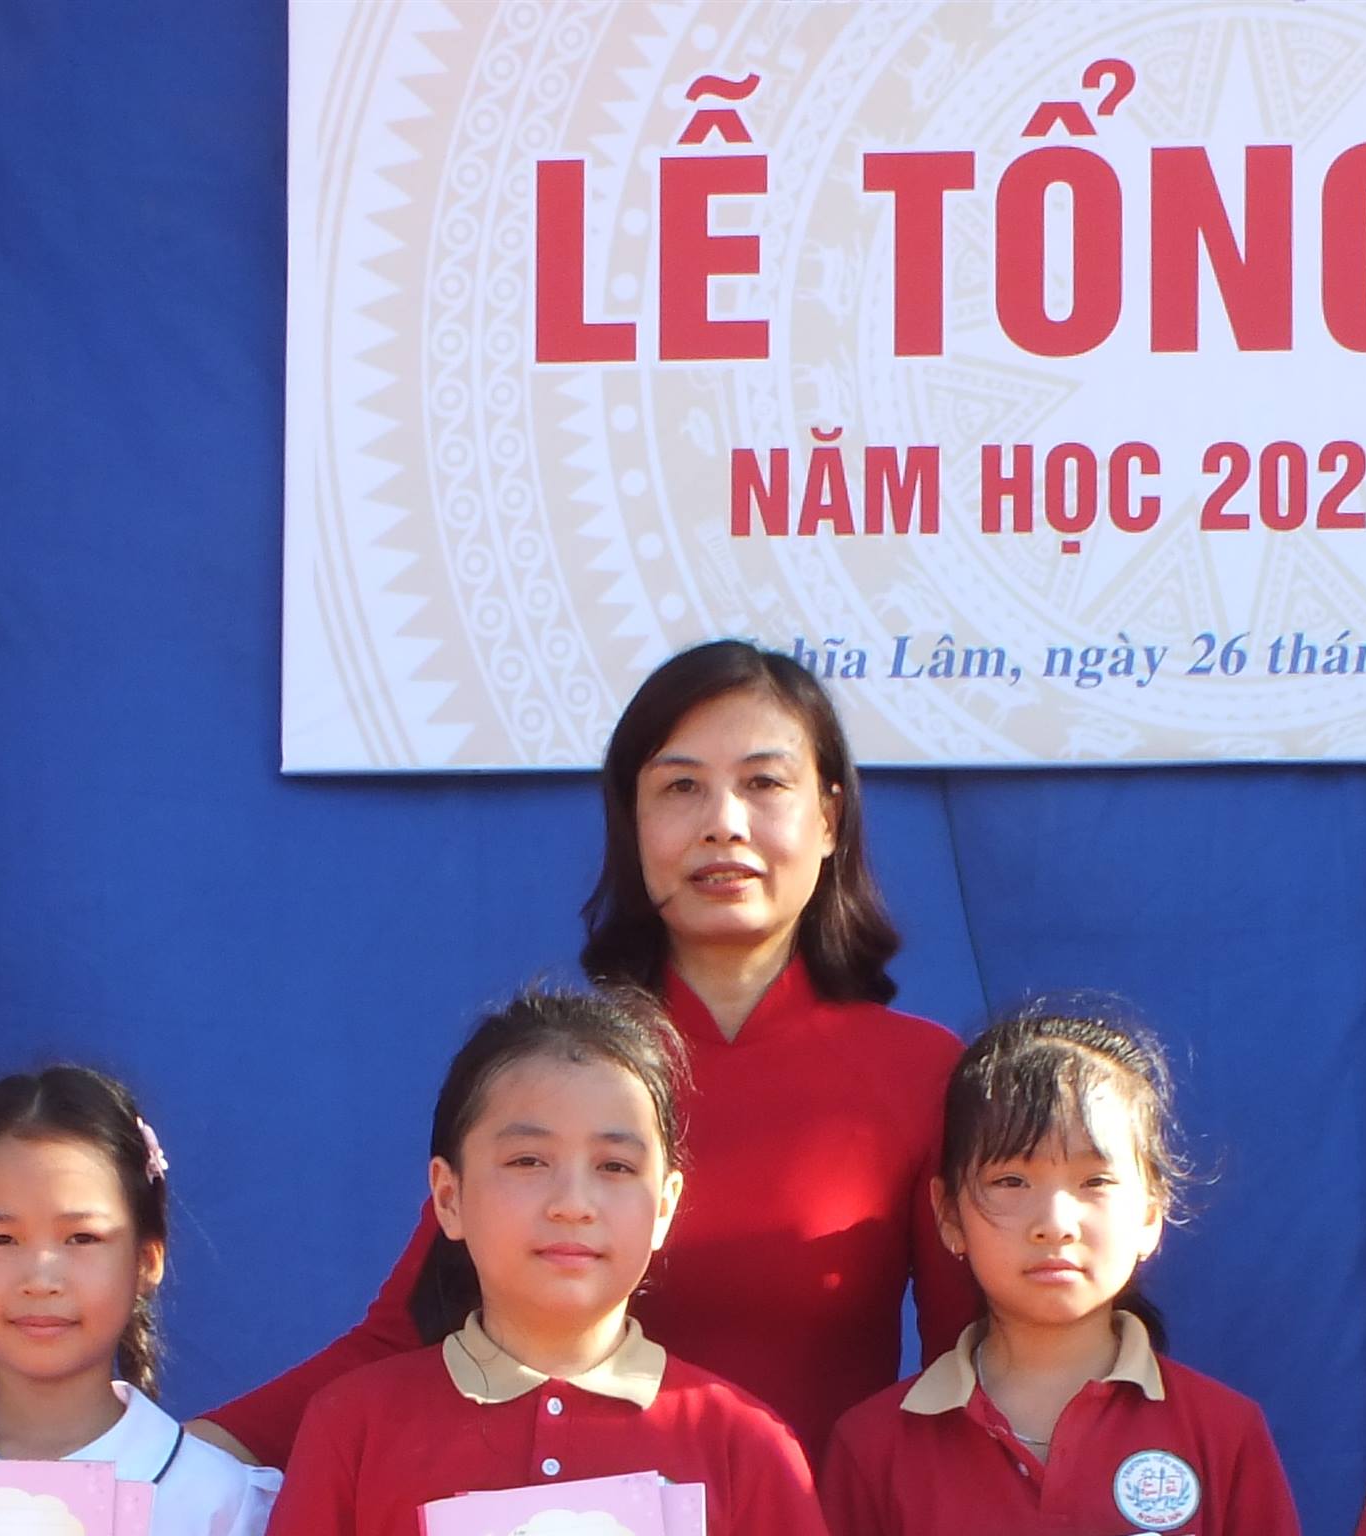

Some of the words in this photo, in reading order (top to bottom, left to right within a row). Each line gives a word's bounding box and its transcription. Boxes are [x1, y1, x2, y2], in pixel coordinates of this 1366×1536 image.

[534, 73, 771, 364] LỄ
[729, 427, 941, 538] NĂM
[980, 441, 1162, 555] HỌC
[747, 636, 869, 681] hĩa
[887, 632, 1023, 684] Lâm,
[1041, 630, 1170, 690] ngày
[1186, 630, 1249, 677] 26
